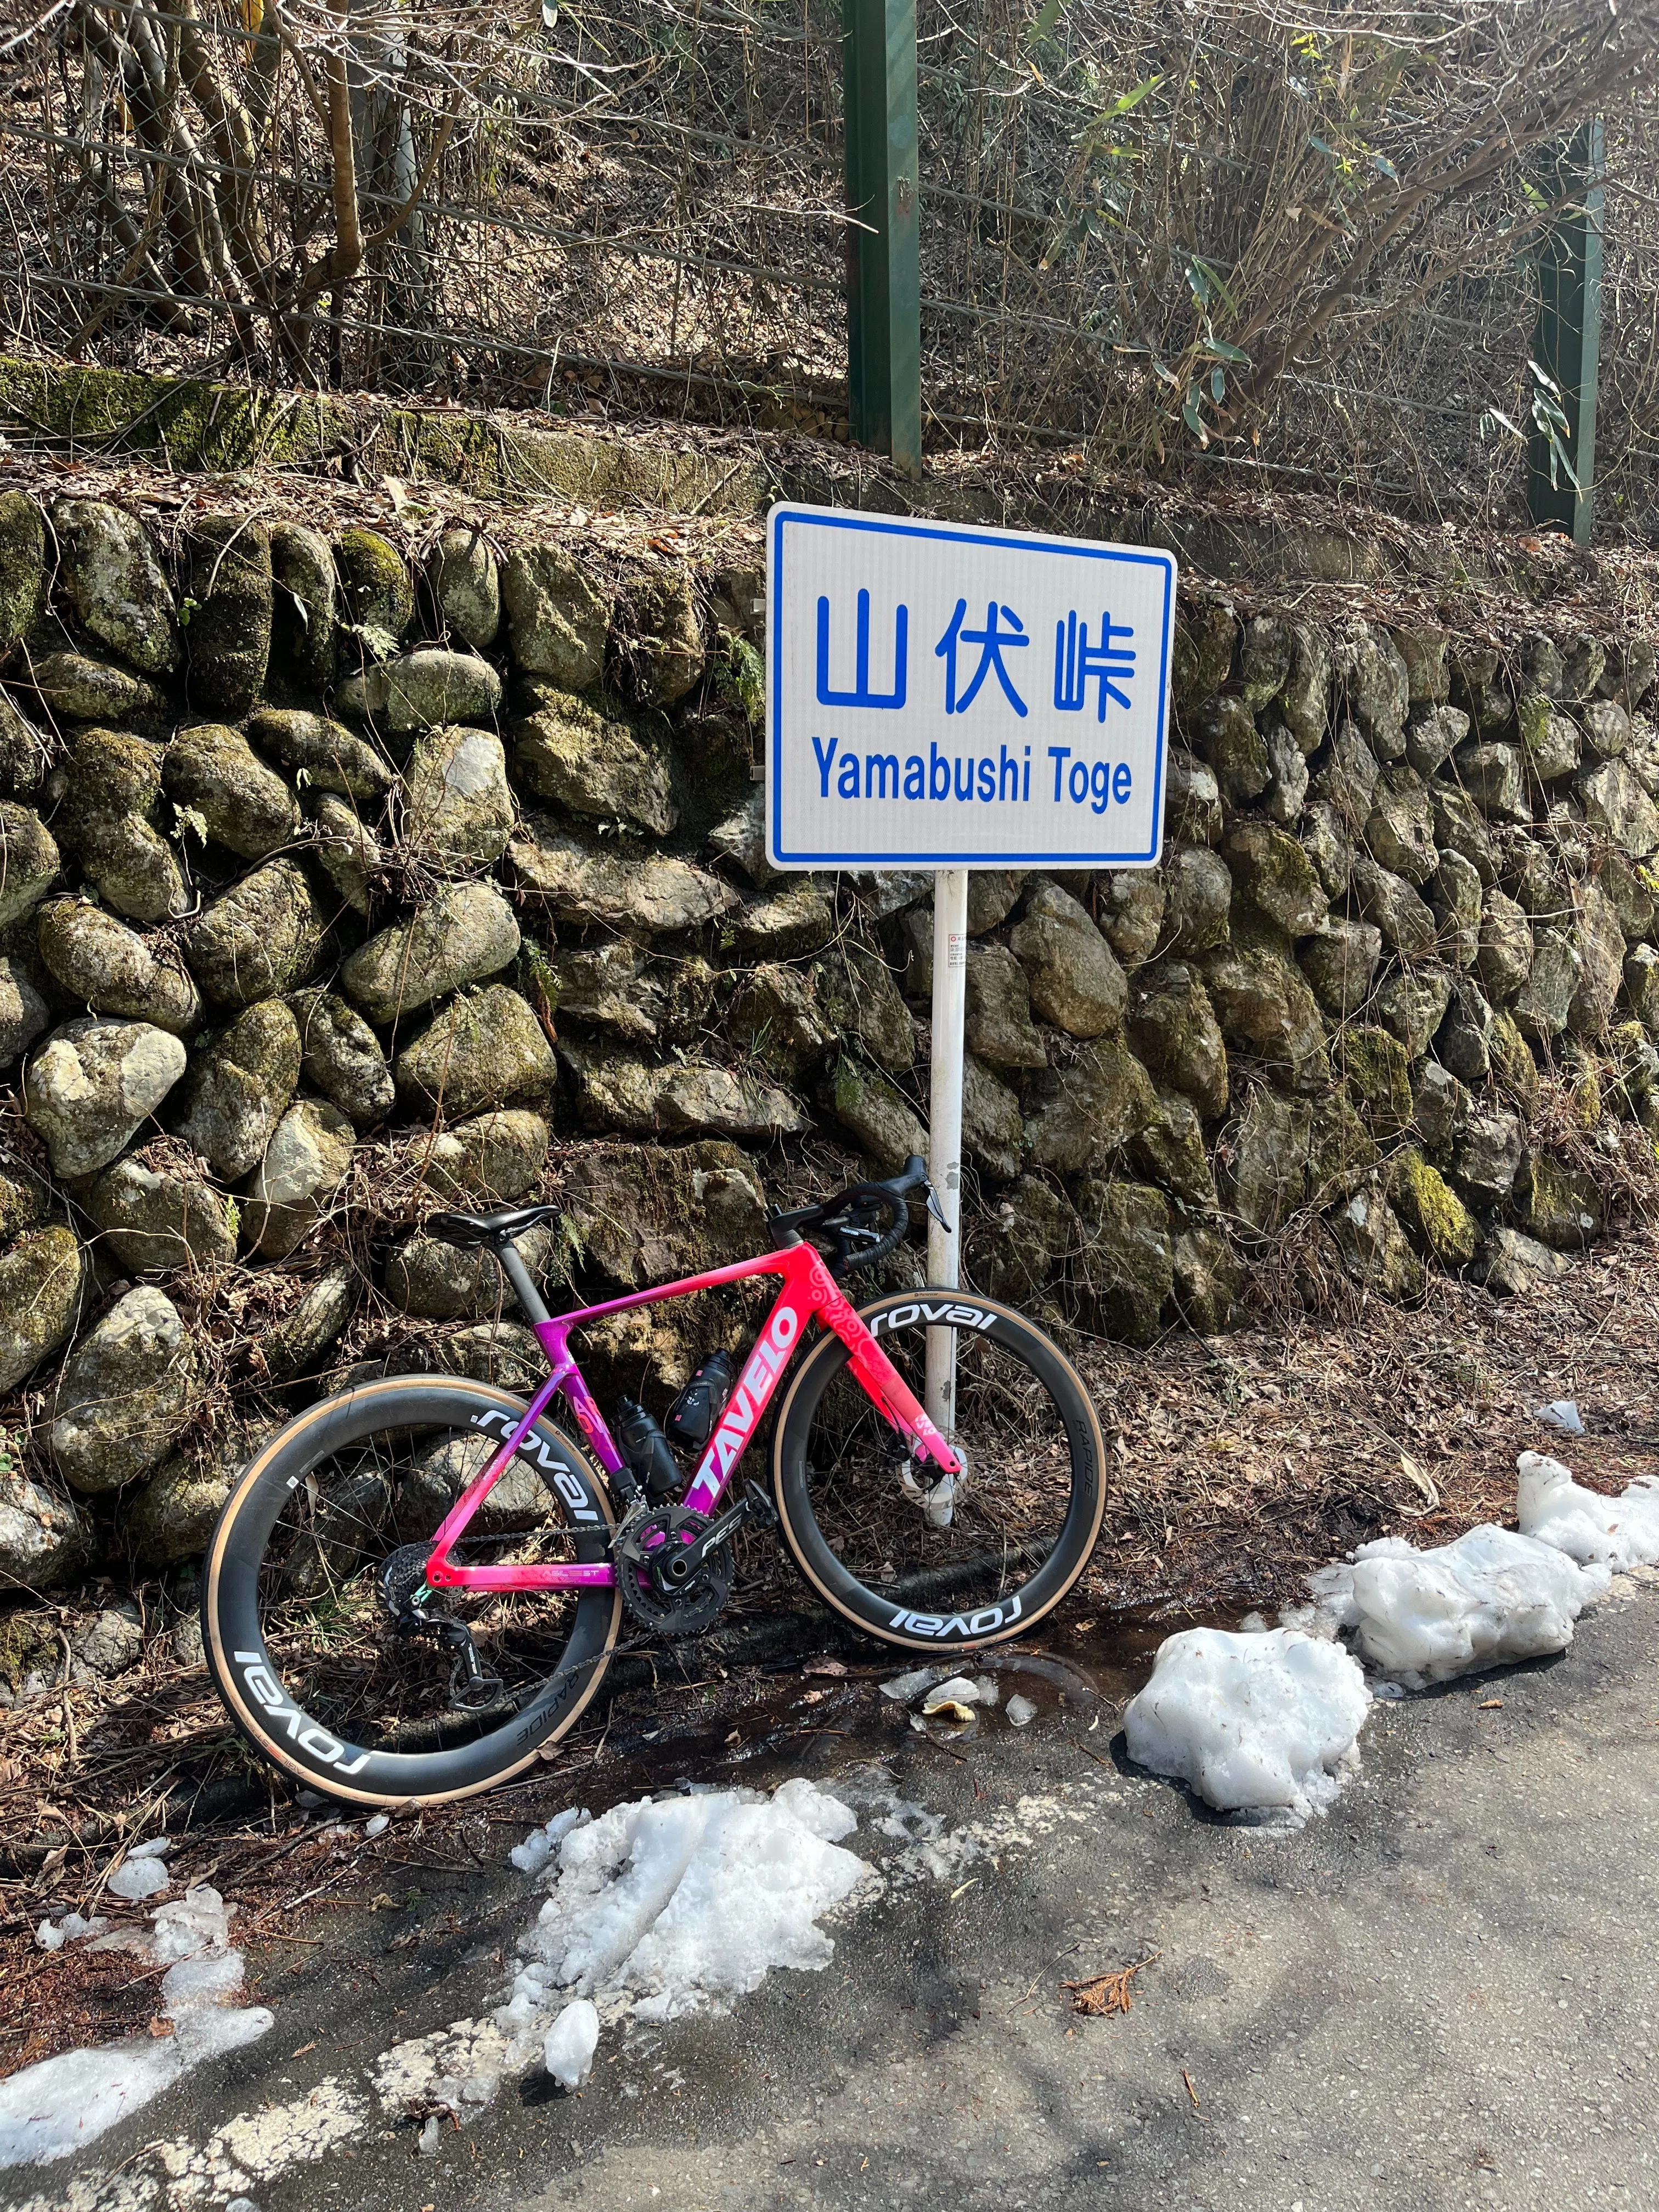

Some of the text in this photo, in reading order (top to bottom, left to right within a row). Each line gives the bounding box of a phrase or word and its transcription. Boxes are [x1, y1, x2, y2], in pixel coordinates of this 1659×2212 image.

[816, 588, 1136, 723] 山伏峠
[811, 737, 1132, 815] Yamabushi Toge
[692, 1306, 798, 1498] TAVELO
[1075, 1420, 1093, 1498] RAPIDE
[517, 1672, 579, 1746] RAPIDE
